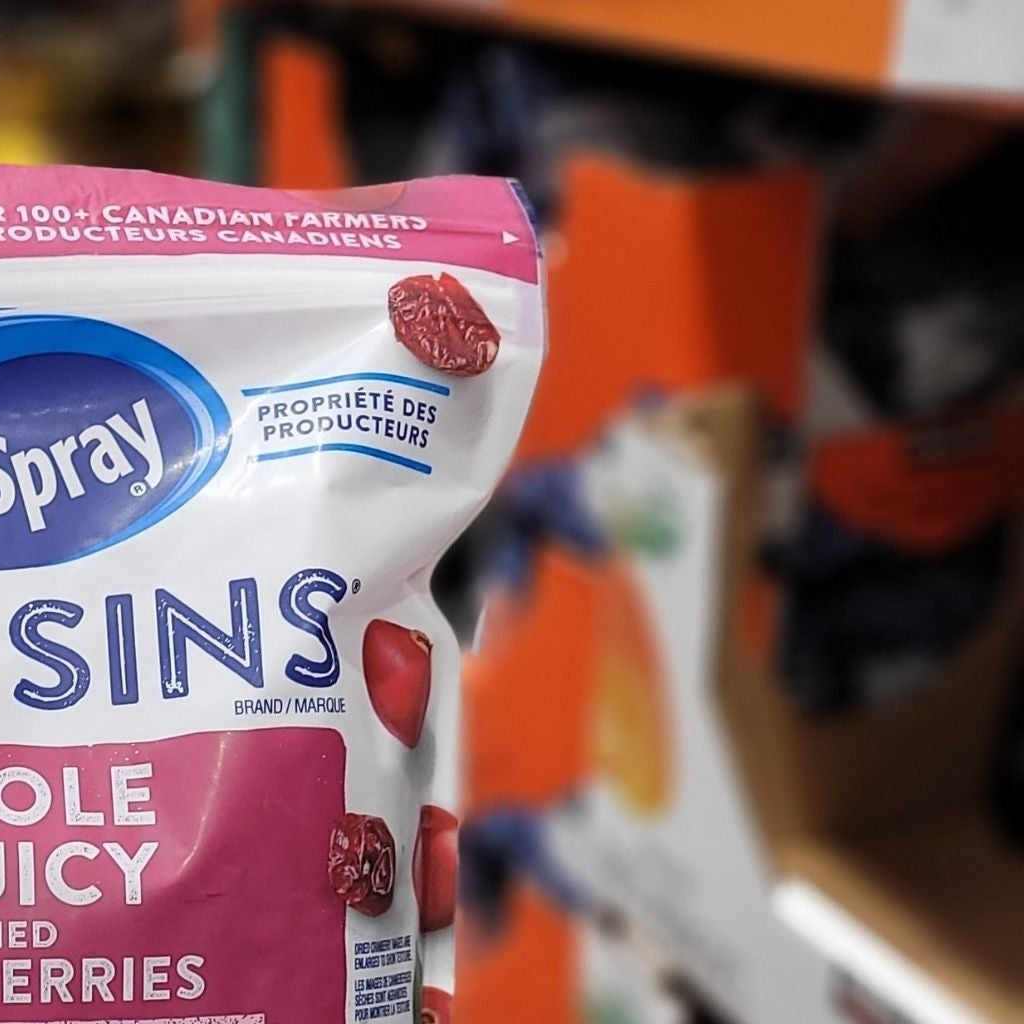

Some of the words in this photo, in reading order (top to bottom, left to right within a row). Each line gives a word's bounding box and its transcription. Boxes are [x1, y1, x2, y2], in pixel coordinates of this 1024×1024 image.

[16, 204, 90, 223] 100+
[102, 204, 274, 227] CANADIAN
[284, 211, 428, 231] FARMERS
[217, 230, 403, 250] CANADIENS
[257, 386, 394, 423] PROPRIÉTÉ
[402, 396, 438, 426] DES
[262, 413, 431, 450] PRODUCTEURS
[234, 700, 285, 717] BRAND
[294, 697, 347, 715] MARQUE
